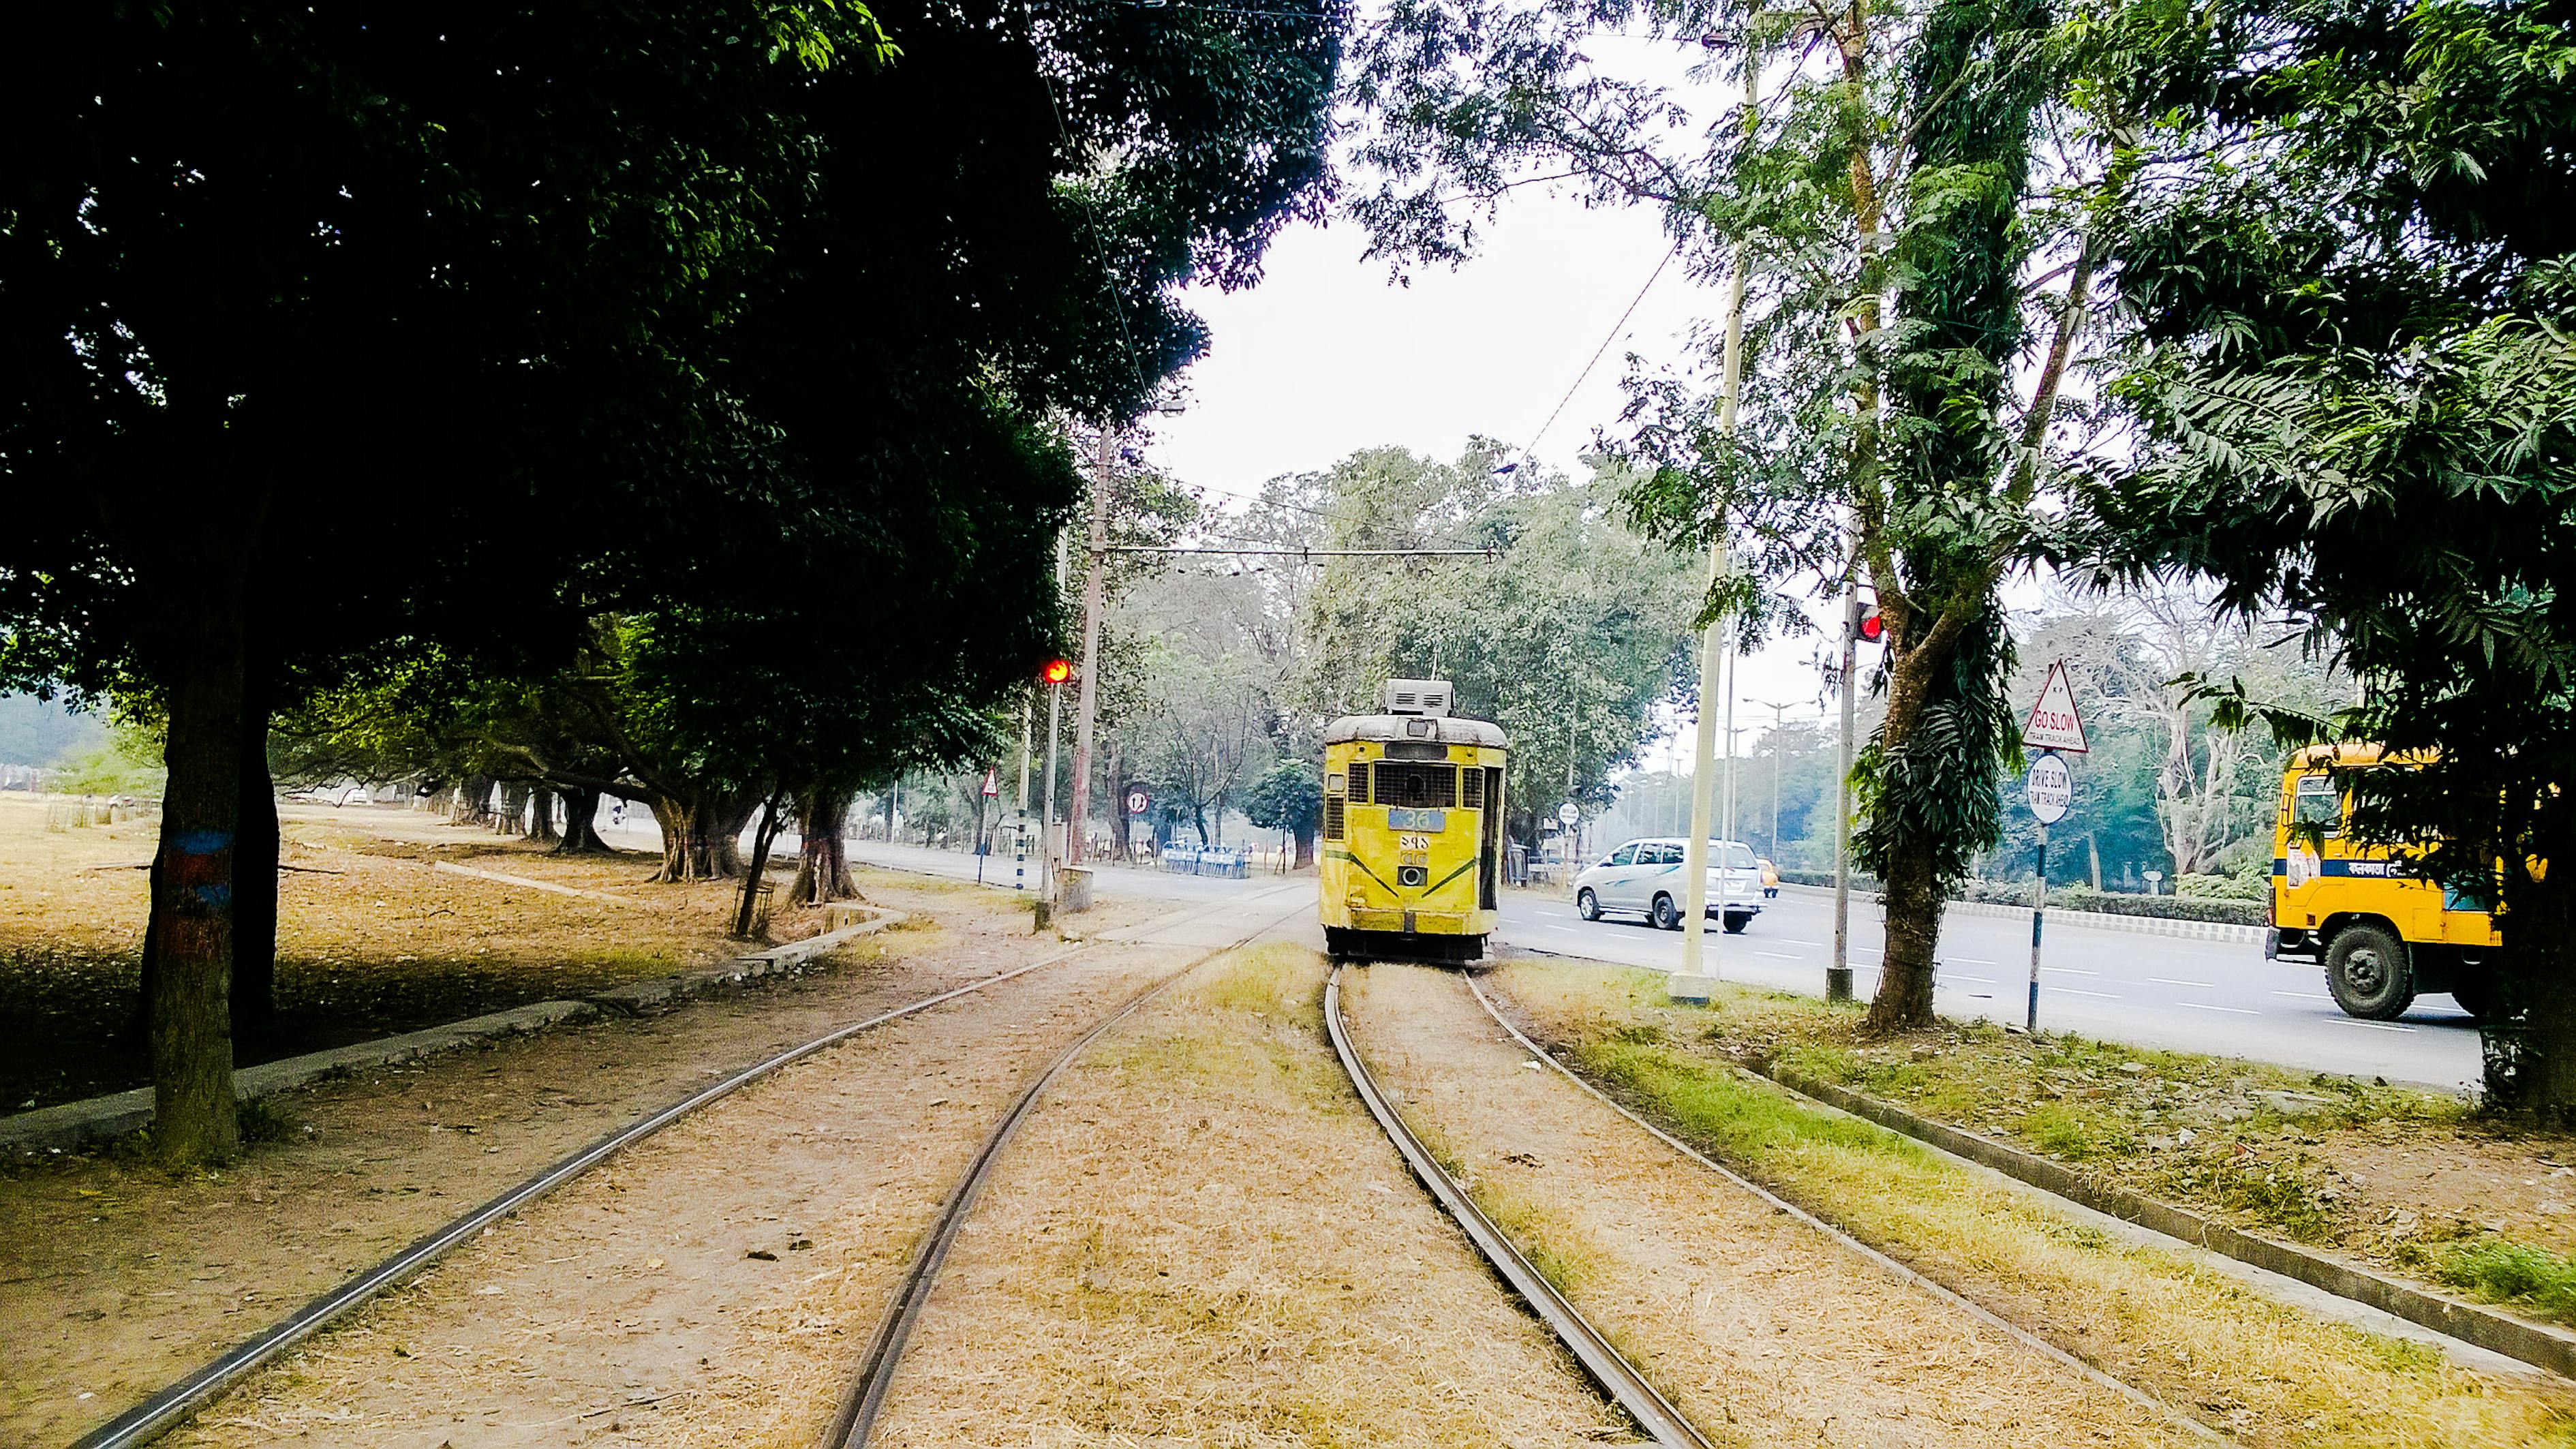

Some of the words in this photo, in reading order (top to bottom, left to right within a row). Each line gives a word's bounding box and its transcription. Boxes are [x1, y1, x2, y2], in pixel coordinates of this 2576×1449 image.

[2035, 710, 2048, 729] GO
[2050, 712, 2074, 732] SLOW
[2029, 731, 2044, 741] TRAM
[2045, 733, 2061, 743] TRACK
[2032, 769, 2049, 788] DRIVE
[2051, 771, 2068, 789] SLOW
[1405, 810, 1429, 829] 36
[2348, 861, 2385, 876] কলকাতা
